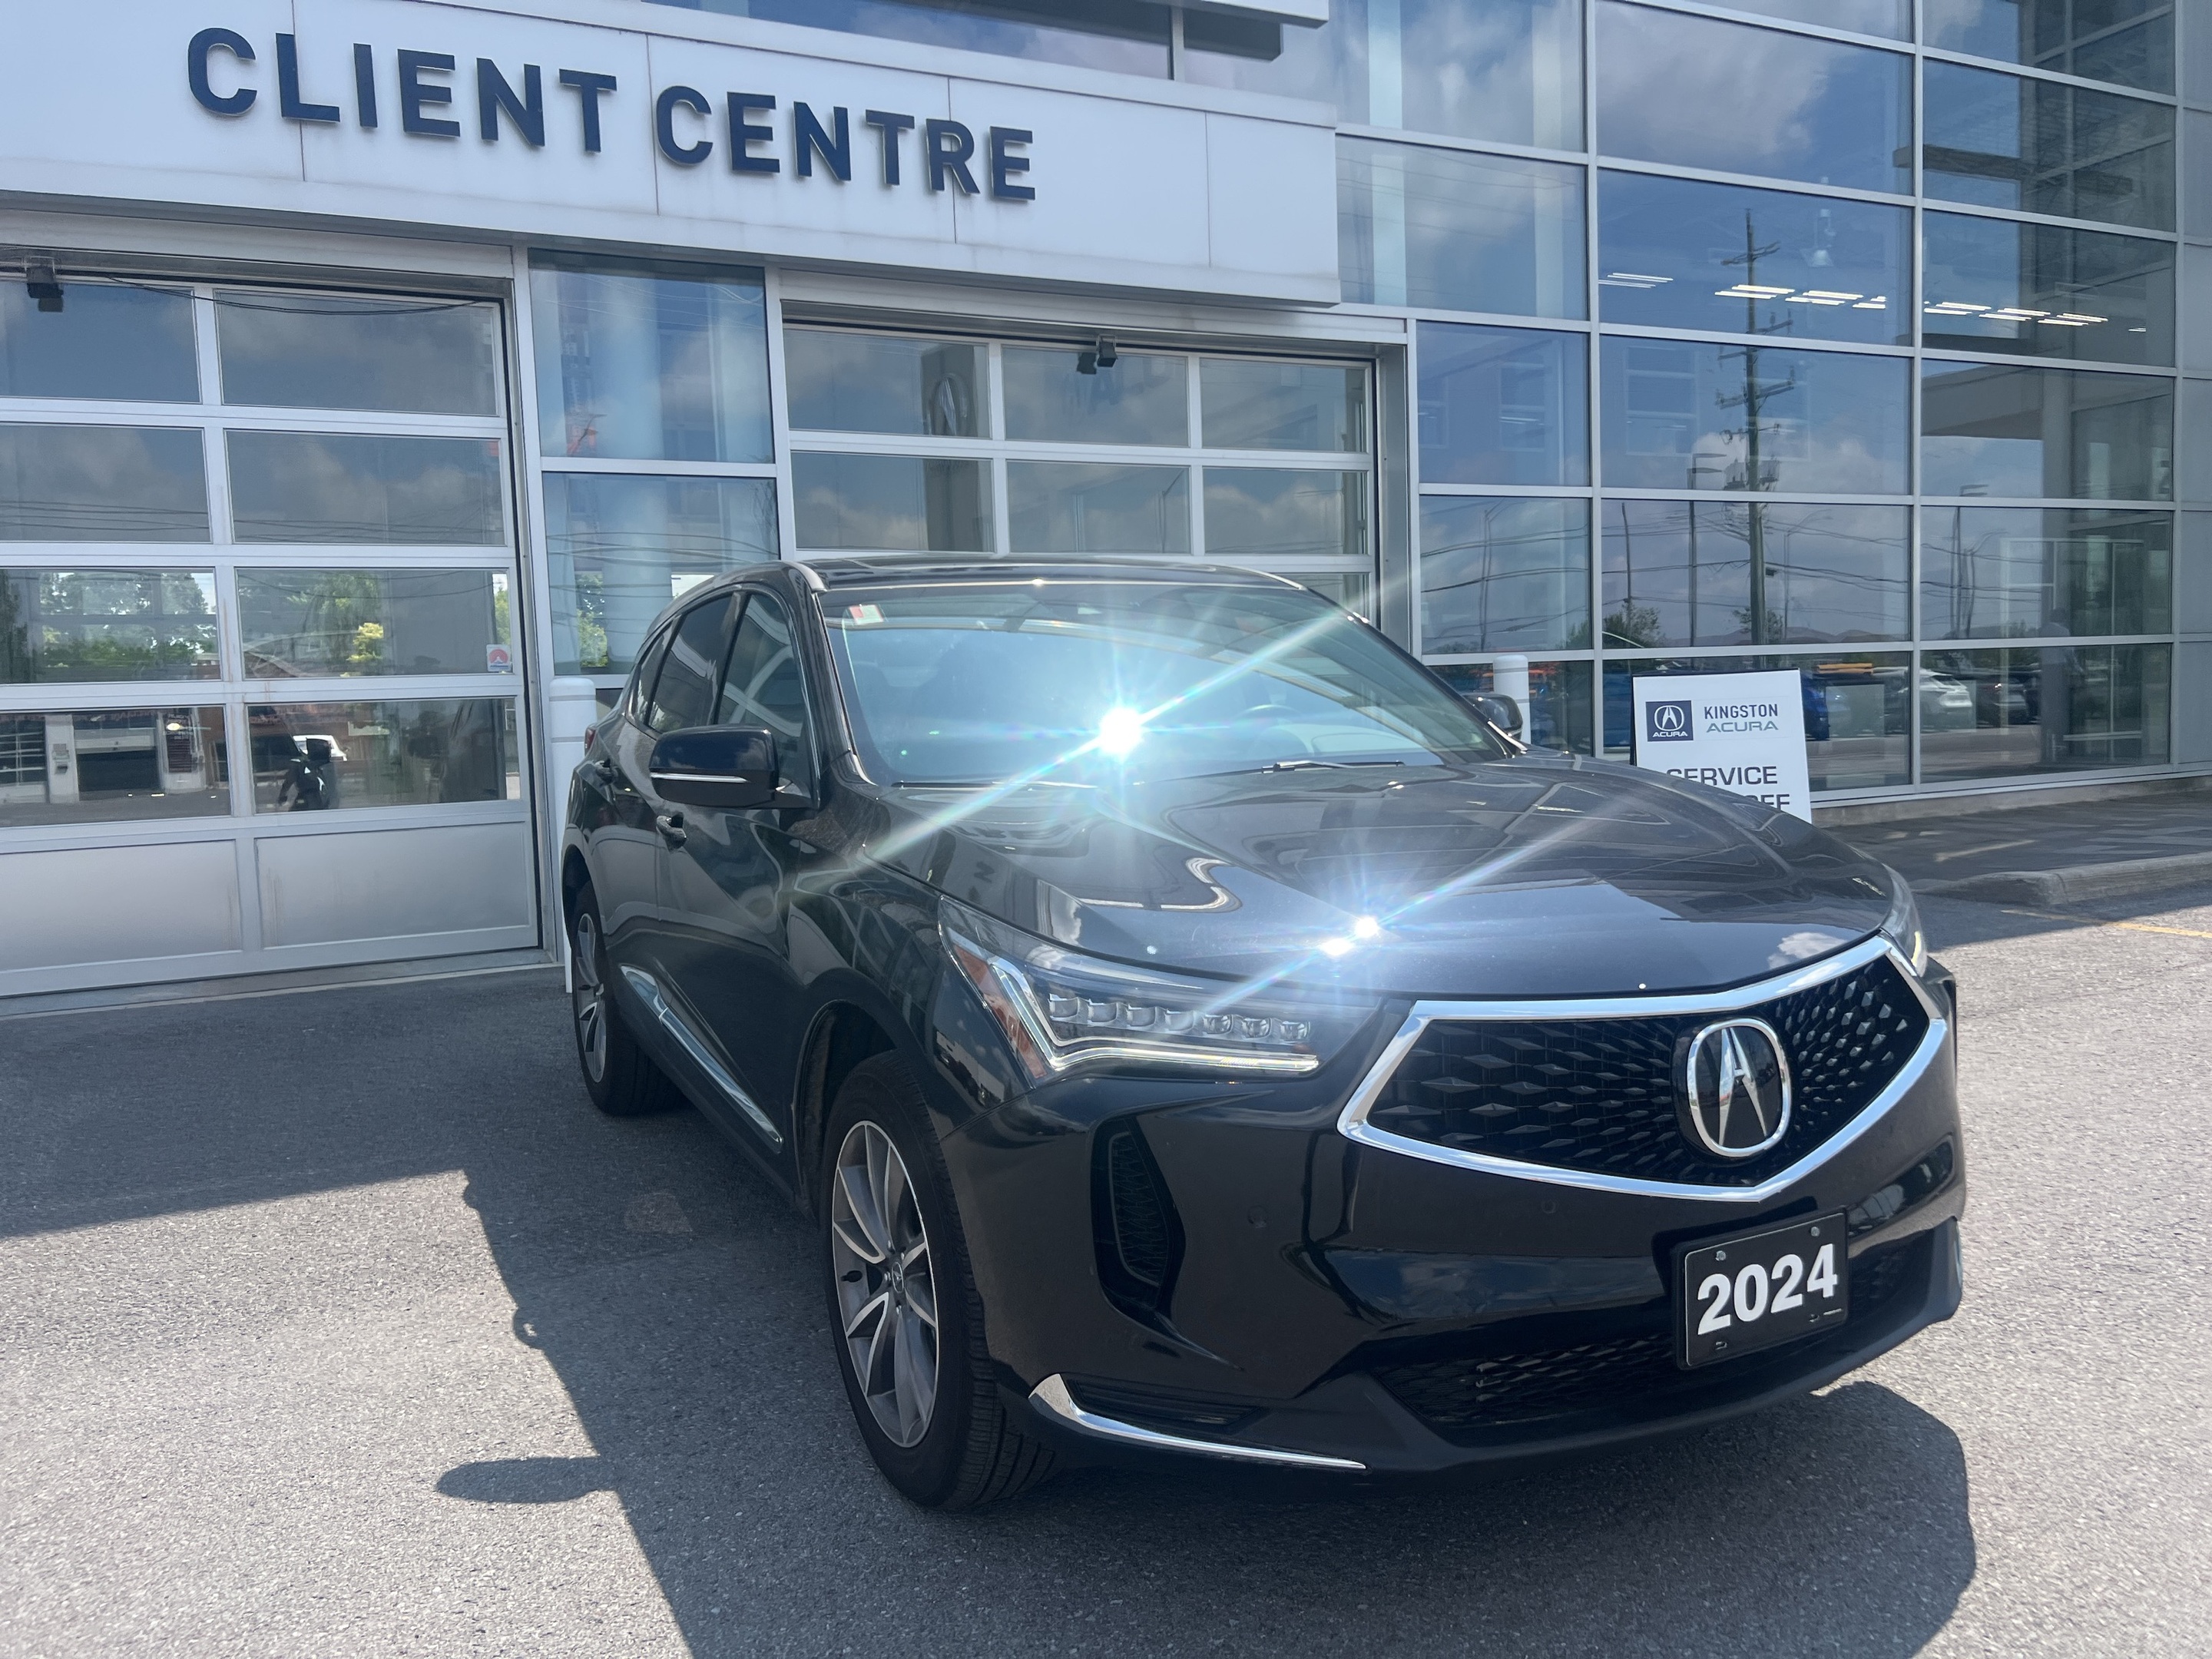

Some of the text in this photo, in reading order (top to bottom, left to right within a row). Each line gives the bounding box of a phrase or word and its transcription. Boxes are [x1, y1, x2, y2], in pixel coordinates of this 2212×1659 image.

[187, 28, 1036, 200] CLIENT CENTRE
[1704, 704, 1778, 720] KINGSTON
[1706, 720, 1778, 733] ACURA
[1744, 793, 1790, 811] FF
[1697, 1243, 1838, 1336] 2024
